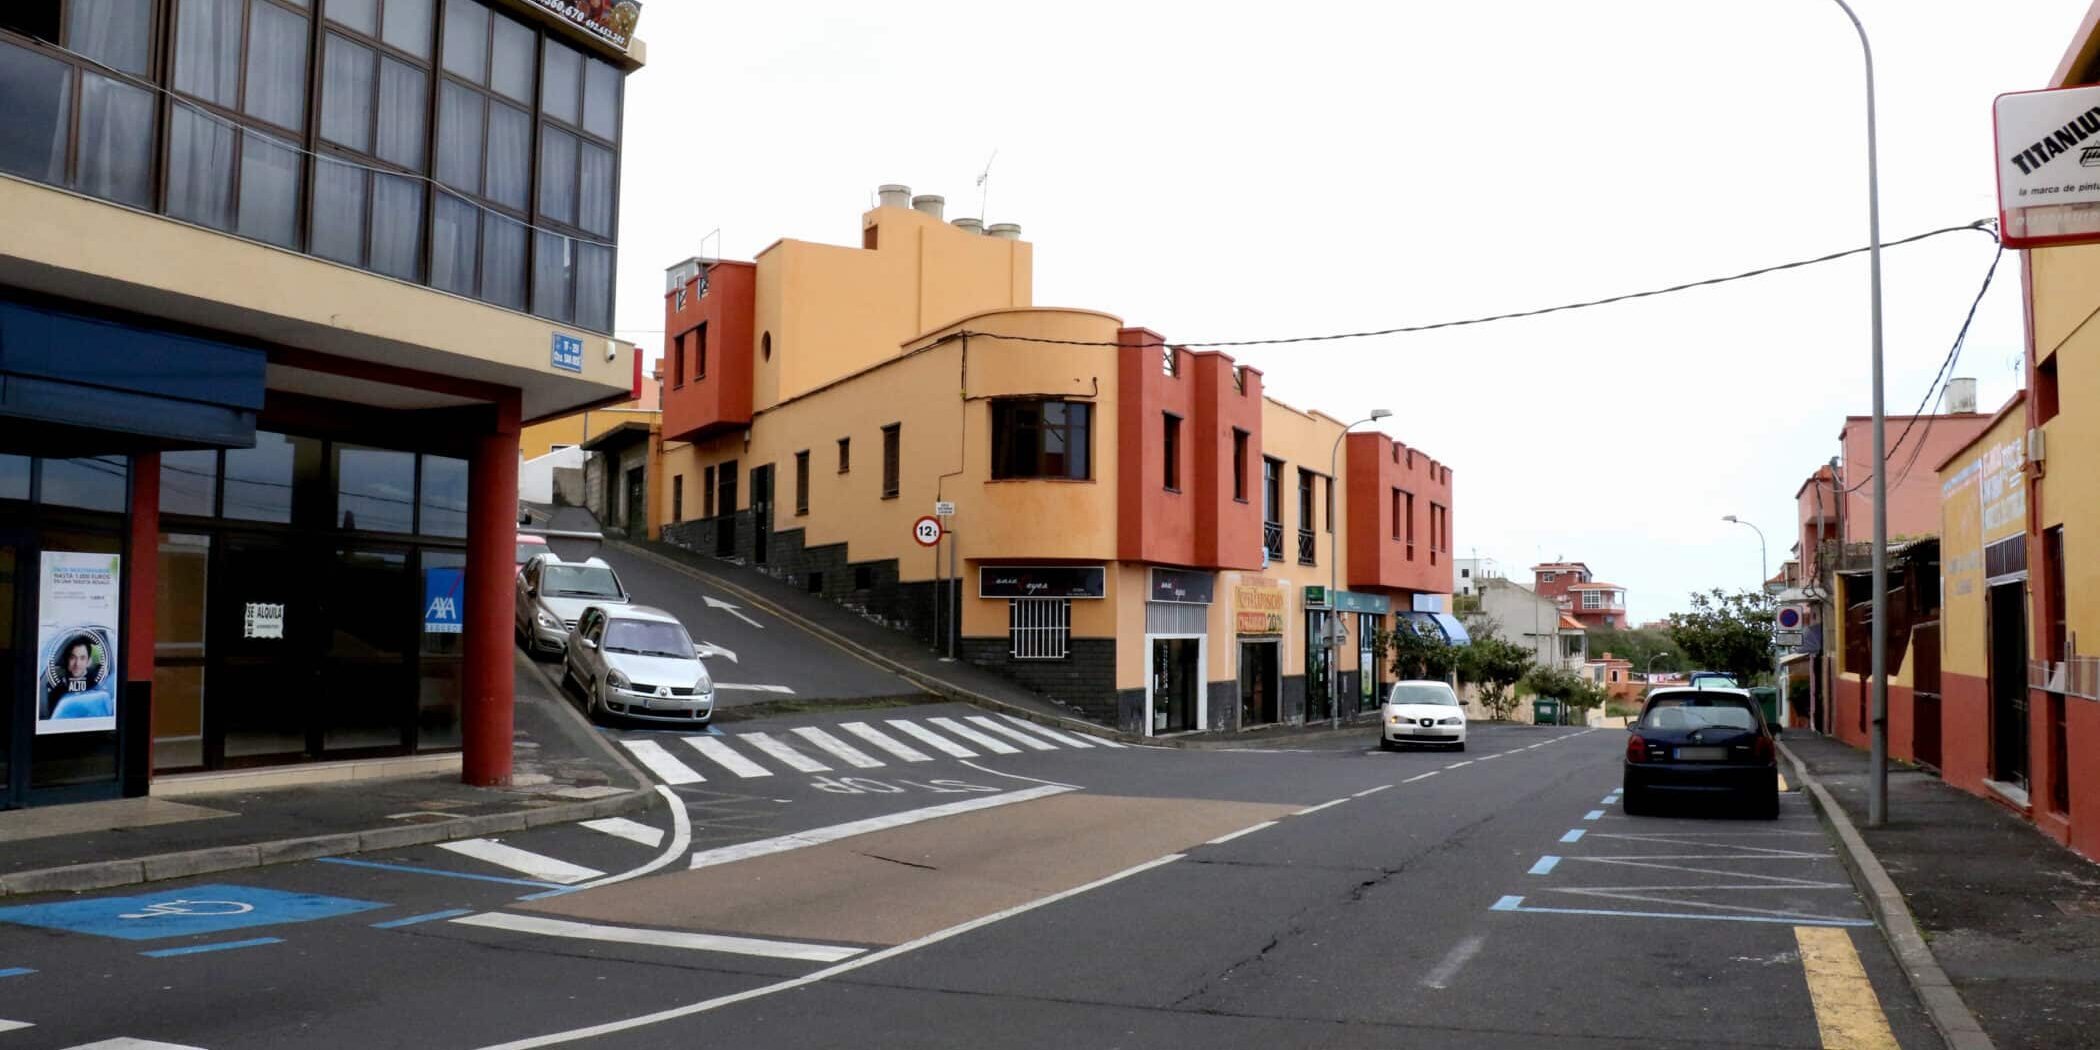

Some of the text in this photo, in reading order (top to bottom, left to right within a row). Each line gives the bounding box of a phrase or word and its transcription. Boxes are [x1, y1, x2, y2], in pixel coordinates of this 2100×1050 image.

[2019, 188, 2027, 196] la
[2031, 186, 2059, 195] marca
[2063, 184, 2075, 193] de
[256, 605, 282, 620] ALQUILA
[425, 597, 456, 619] AXA
[68, 680, 87, 691] ALTO
